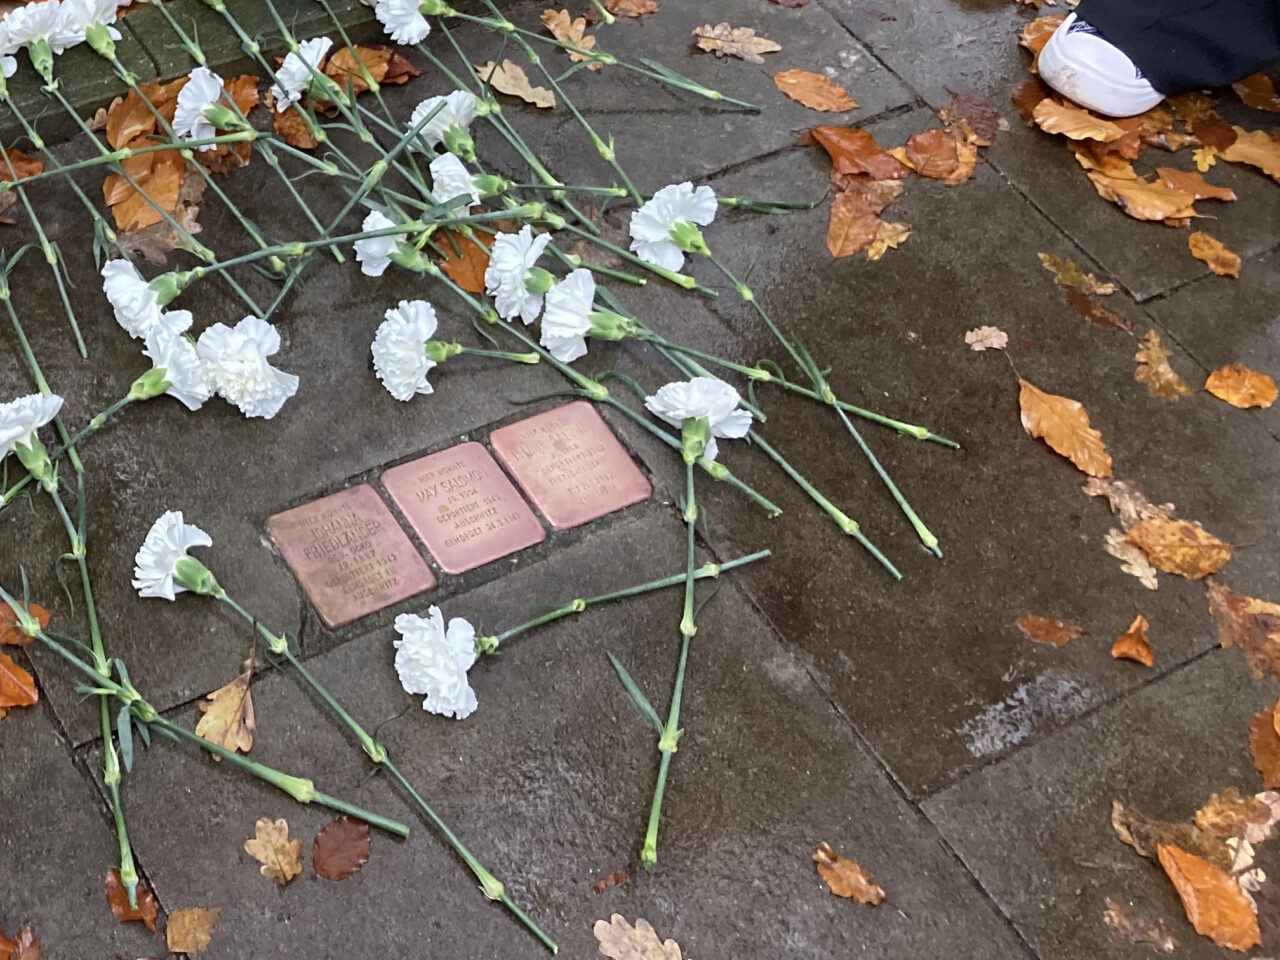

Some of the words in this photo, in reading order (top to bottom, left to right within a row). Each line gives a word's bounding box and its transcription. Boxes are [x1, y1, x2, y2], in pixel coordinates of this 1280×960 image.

[415, 483, 439, 504] MAX
[440, 467, 489, 493] SALOMON
[436, 501, 480, 524] DEPORTIERT
[454, 506, 499, 530] AUSCHWITZ
[302, 519, 384, 561] FRIEDLÄNDER
[310, 511, 363, 542] JOHANNA
[443, 526, 484, 548] ERMORDET
